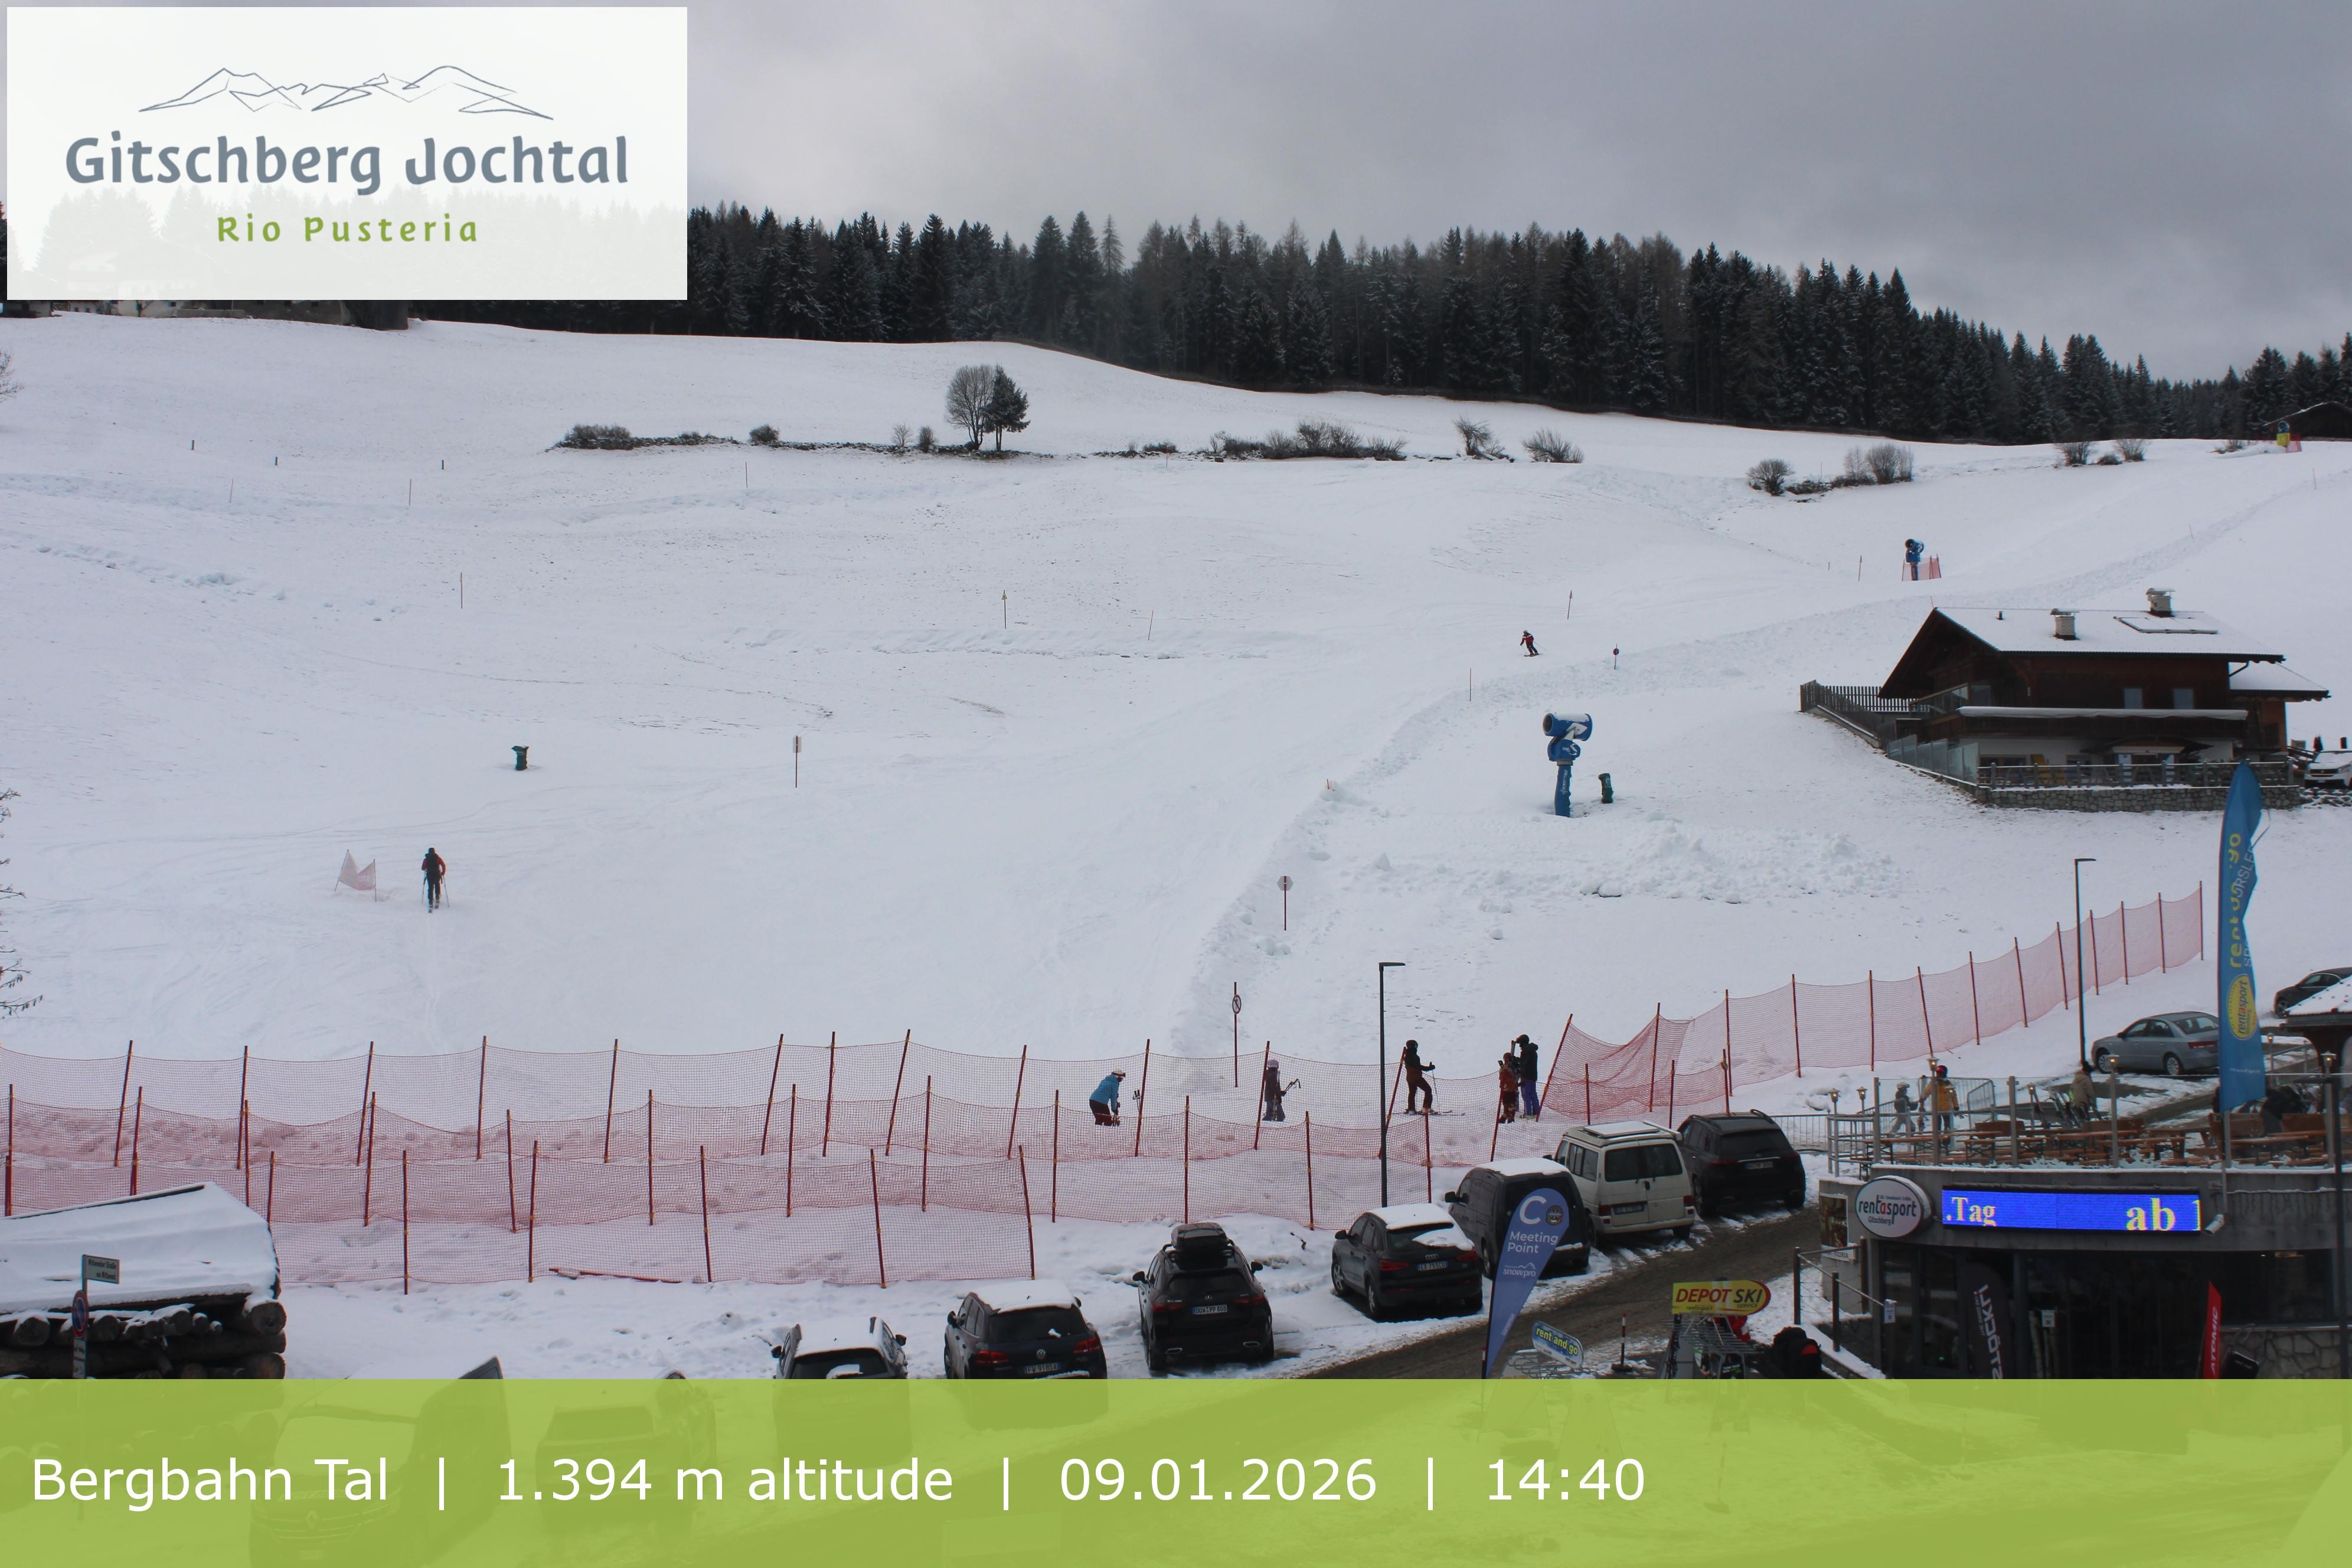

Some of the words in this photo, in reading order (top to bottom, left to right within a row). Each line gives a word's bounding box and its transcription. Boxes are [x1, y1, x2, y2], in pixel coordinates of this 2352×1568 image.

[1519, 1195, 1547, 1226] C
[1858, 1194, 1916, 1225] rentasport
[2126, 1197, 2175, 1231] ab
[1507, 1242, 1540, 1253] Point
[1510, 1231, 1559, 1245] Meeting
[1675, 1288, 1733, 1303] DEPOT
[1733, 1288, 1763, 1304] SKI
[1536, 1327, 1553, 1342] rent
[1553, 1335, 1569, 1350] and
[1568, 1344, 1579, 1355] go
[2210, 1305, 2219, 1376] ATOMIC
